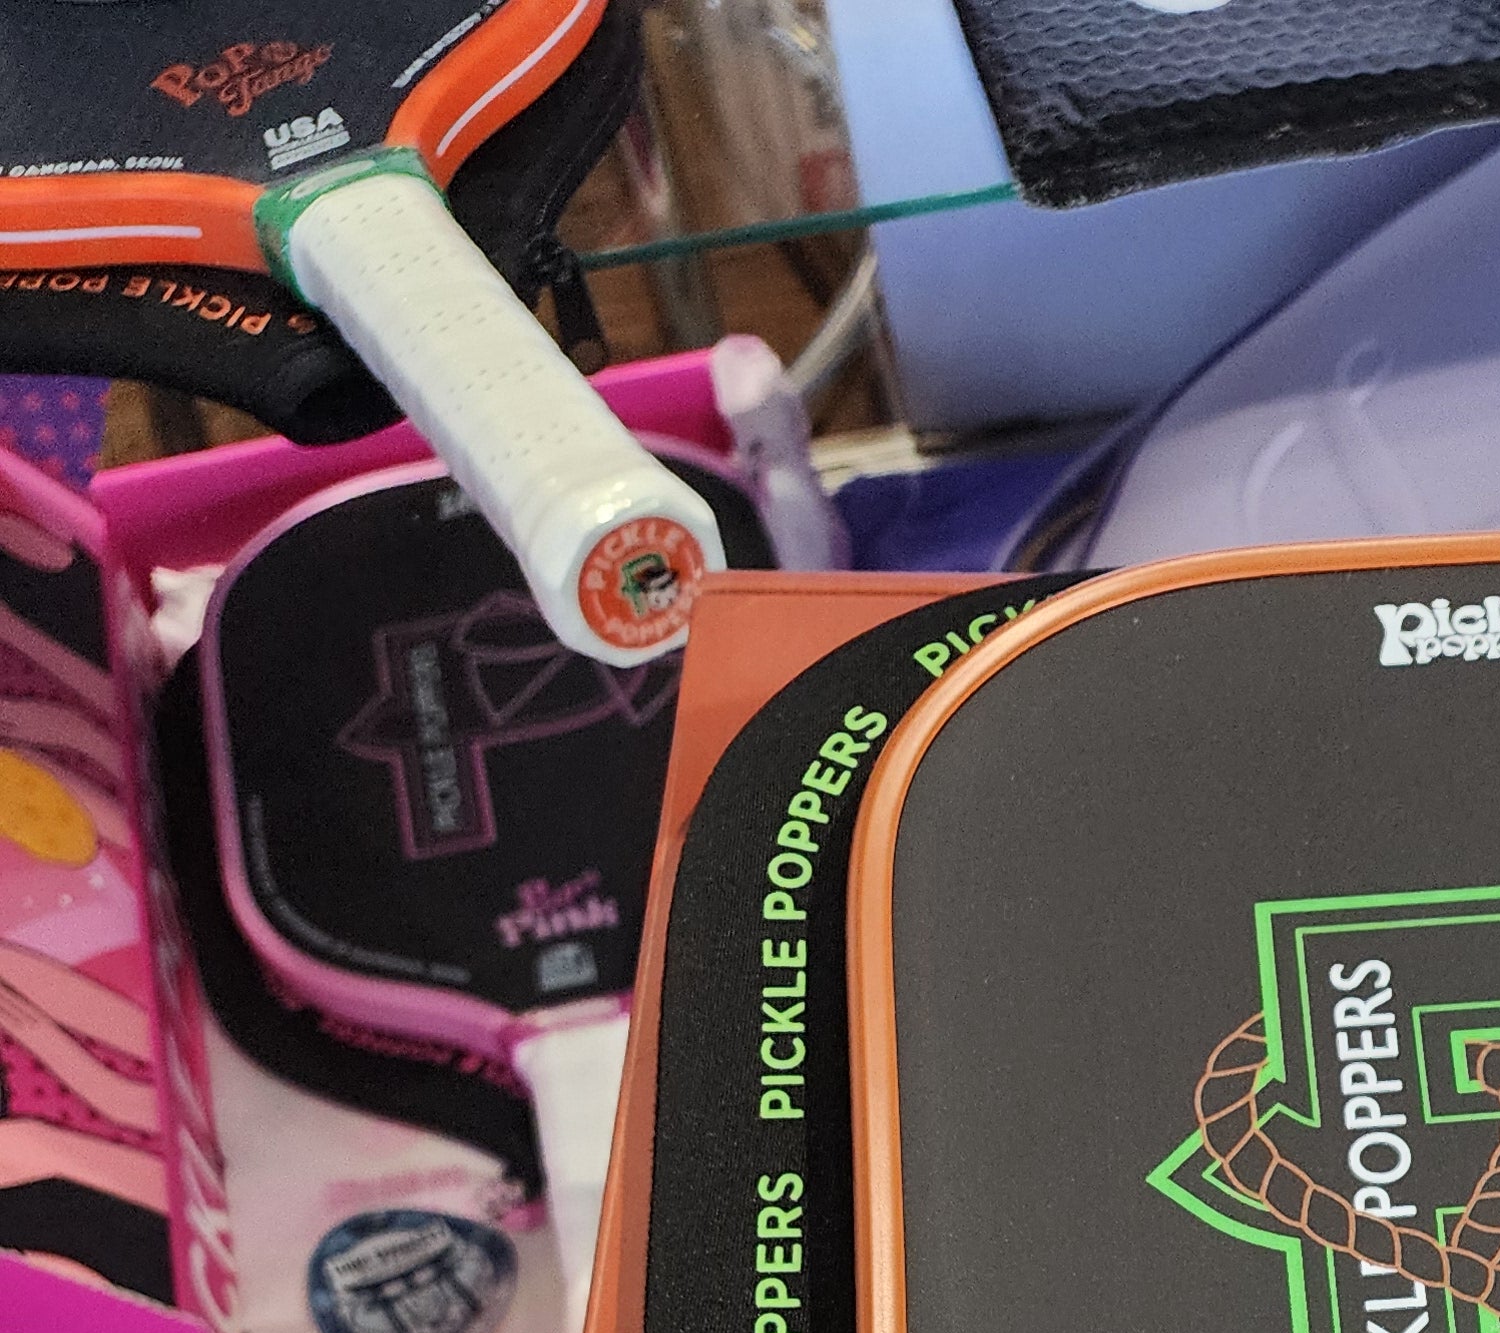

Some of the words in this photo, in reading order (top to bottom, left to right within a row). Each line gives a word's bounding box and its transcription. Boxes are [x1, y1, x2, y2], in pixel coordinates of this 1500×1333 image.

[263, 107, 345, 148] USA
[122, 275, 273, 336] PICKLE
[762, 704, 889, 921] POPPERS
[758, 937, 808, 1120] PICKLE
[1329, 958, 1418, 1220] POPPERS
